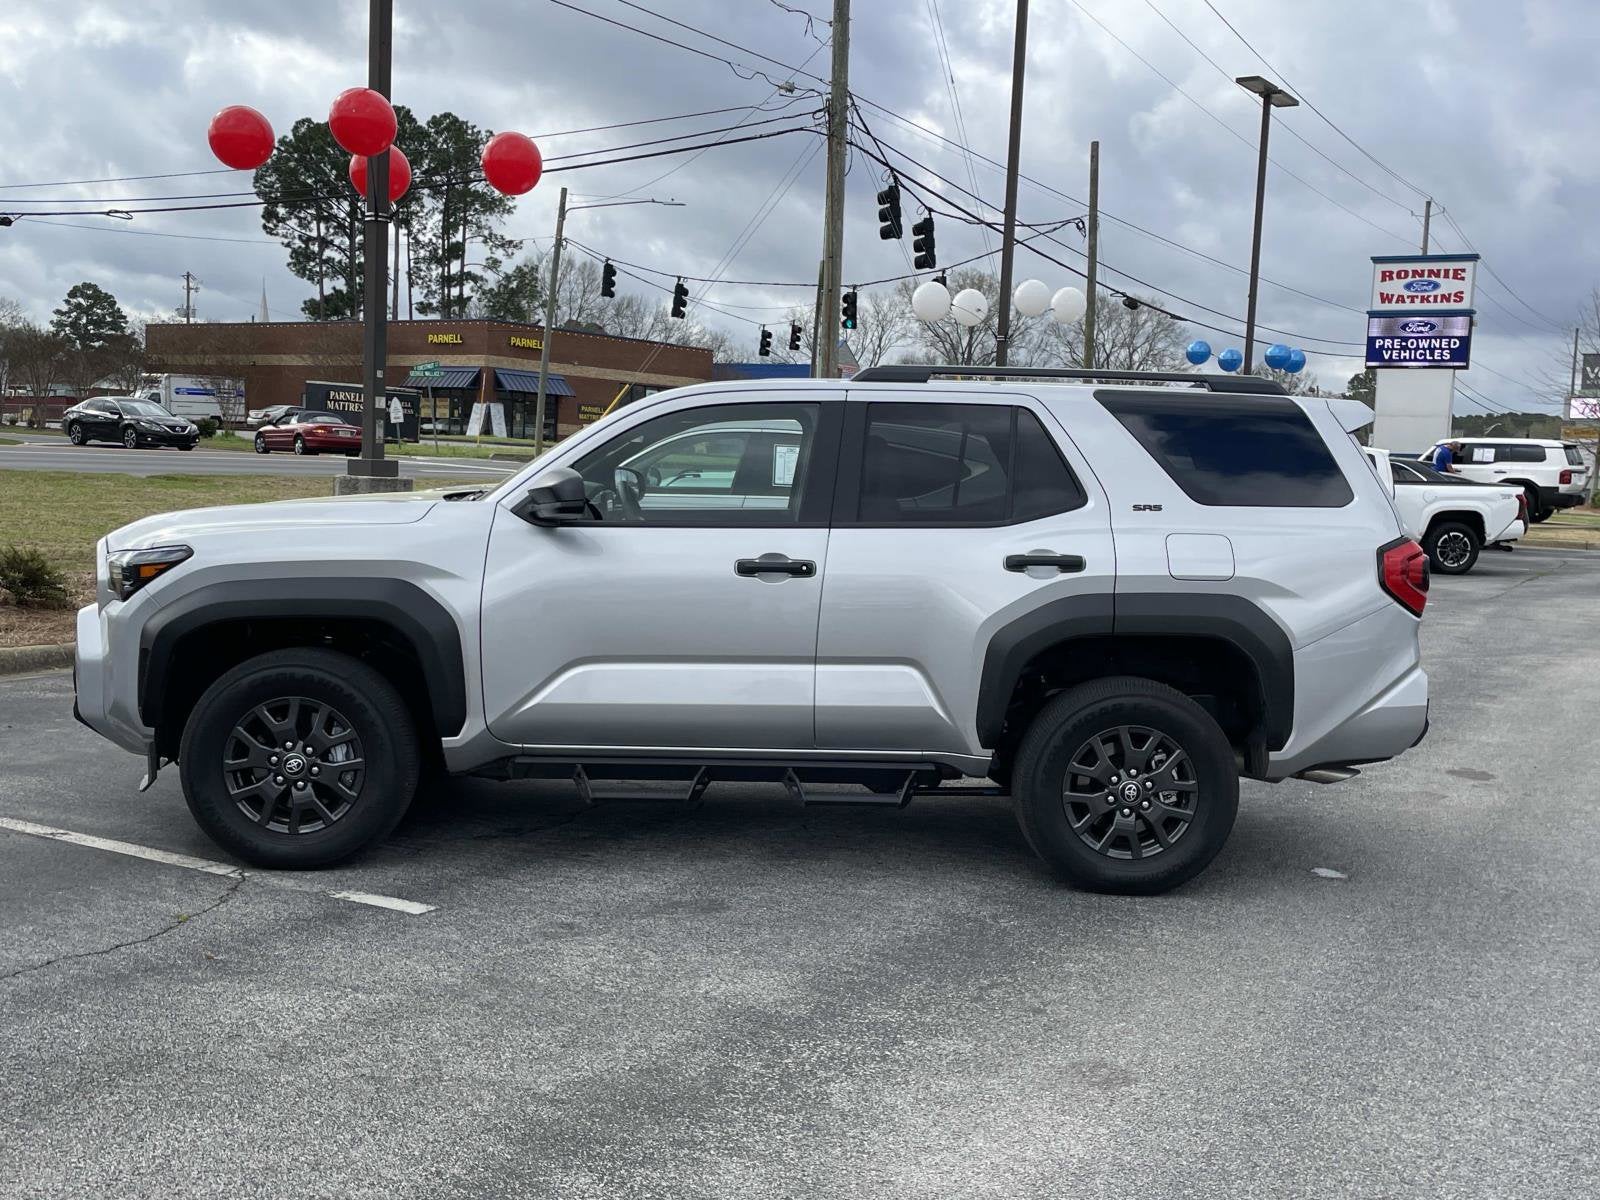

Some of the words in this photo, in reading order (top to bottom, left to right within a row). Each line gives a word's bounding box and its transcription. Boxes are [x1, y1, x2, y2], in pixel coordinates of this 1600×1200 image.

[1380, 268, 1466, 283] RONNIE
[1410, 281, 1434, 292] Ford
[1379, 290, 1465, 304] WATKINS
[1405, 322, 1431, 332] Ford
[428, 334, 462, 343] PARNELL
[1375, 338, 1460, 349] PRE-OWNED
[1382, 349, 1451, 360] VEHICLES
[326, 400, 364, 412] MATTRES
